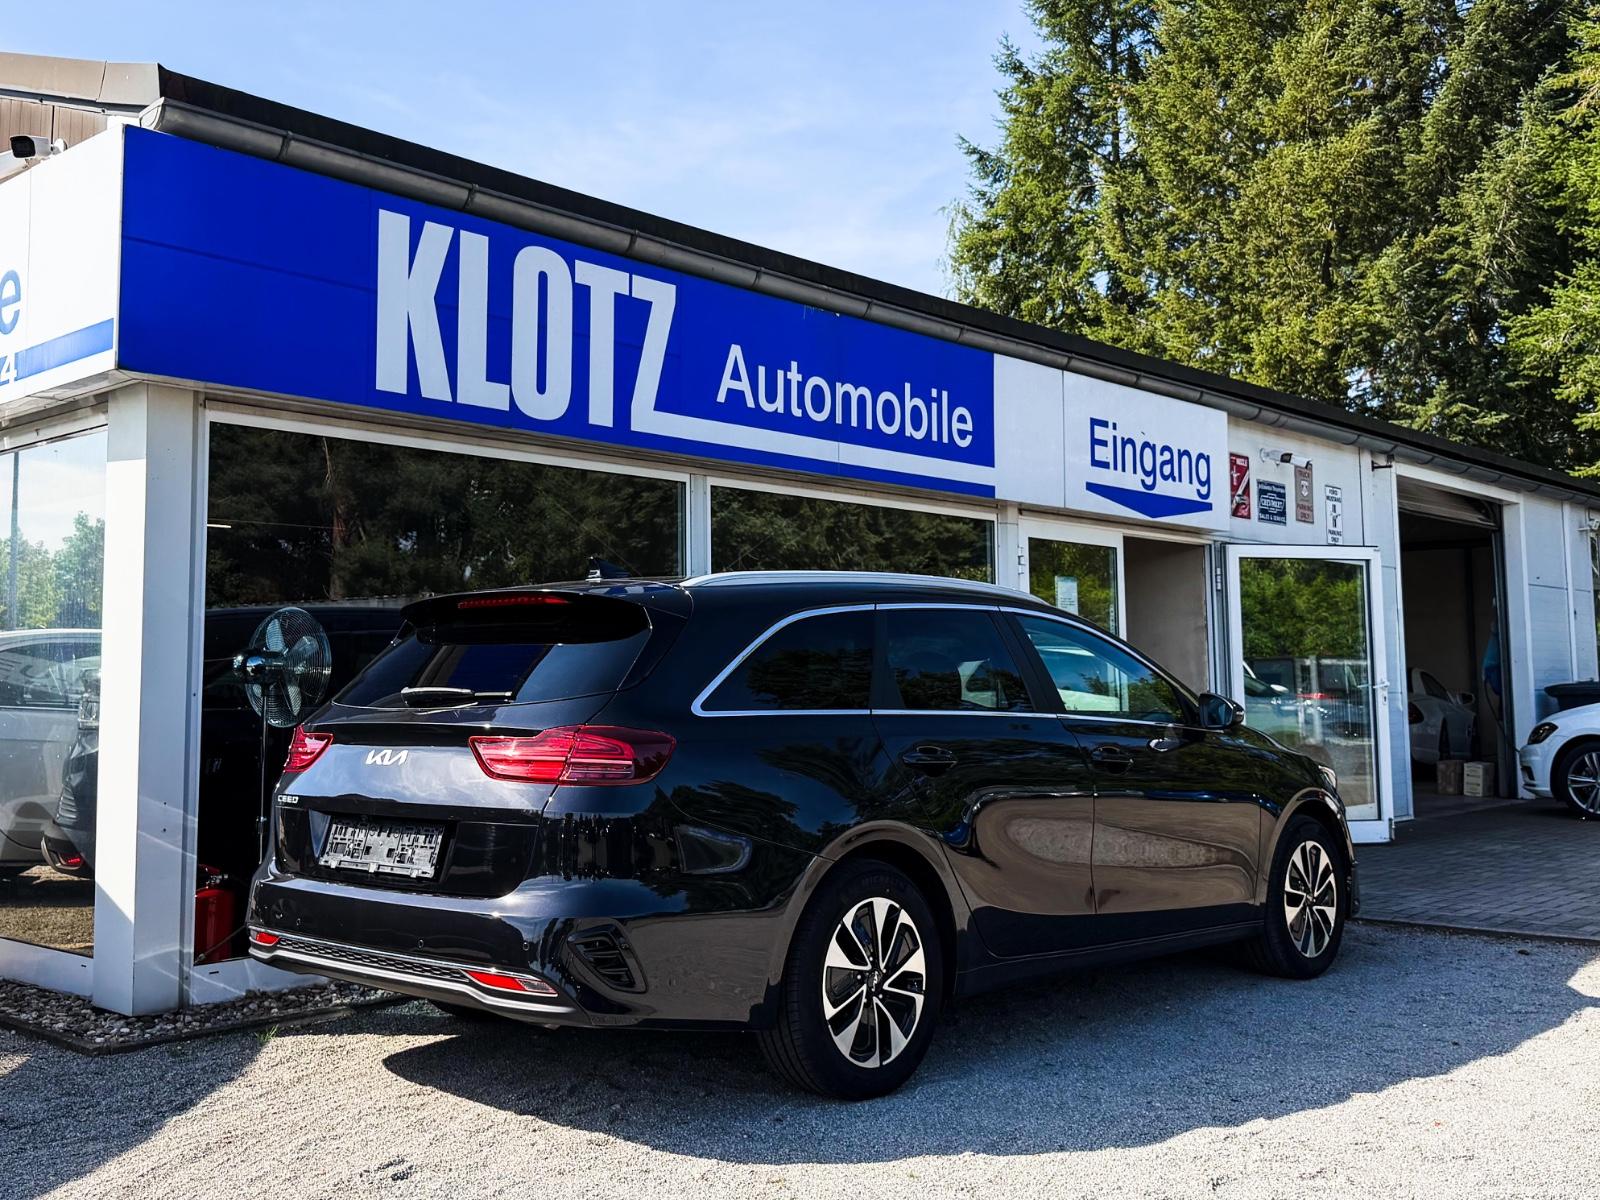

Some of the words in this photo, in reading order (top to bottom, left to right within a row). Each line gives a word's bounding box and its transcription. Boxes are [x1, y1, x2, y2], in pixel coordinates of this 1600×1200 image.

[376, 208, 677, 434] KLOTZ
[716, 343, 973, 448] Automobile
[1090, 417, 1211, 500] Eingang
